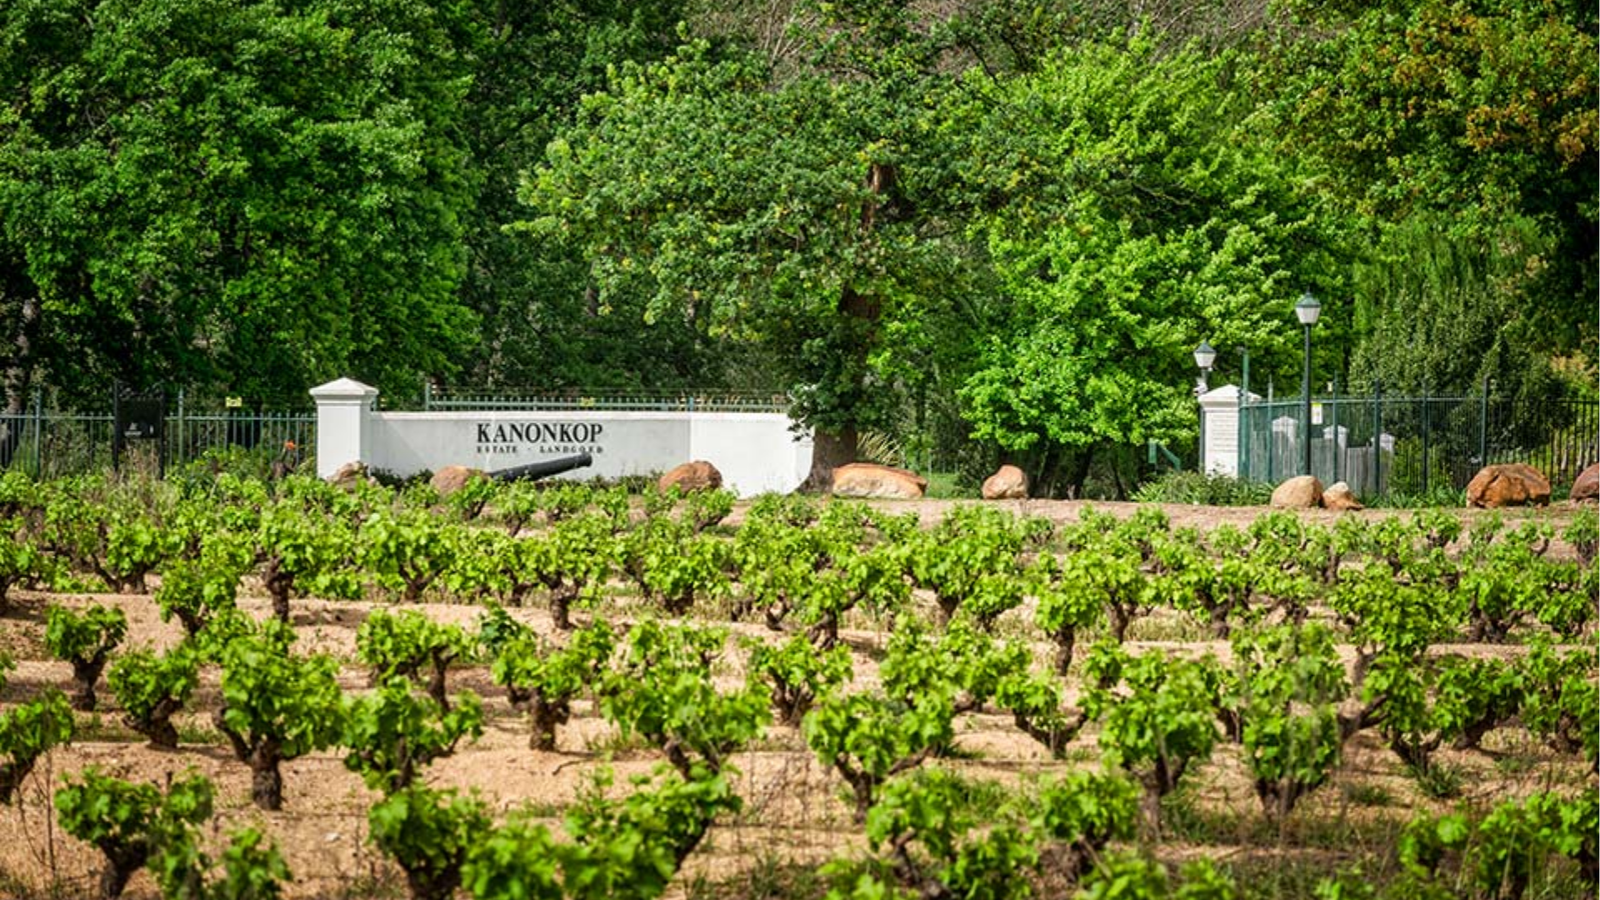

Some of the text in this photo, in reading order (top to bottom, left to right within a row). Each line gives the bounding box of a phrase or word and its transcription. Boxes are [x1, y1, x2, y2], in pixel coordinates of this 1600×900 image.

[477, 423, 603, 443] KANONKOP
[477, 445, 603, 453] ESTATE LANDGOED
